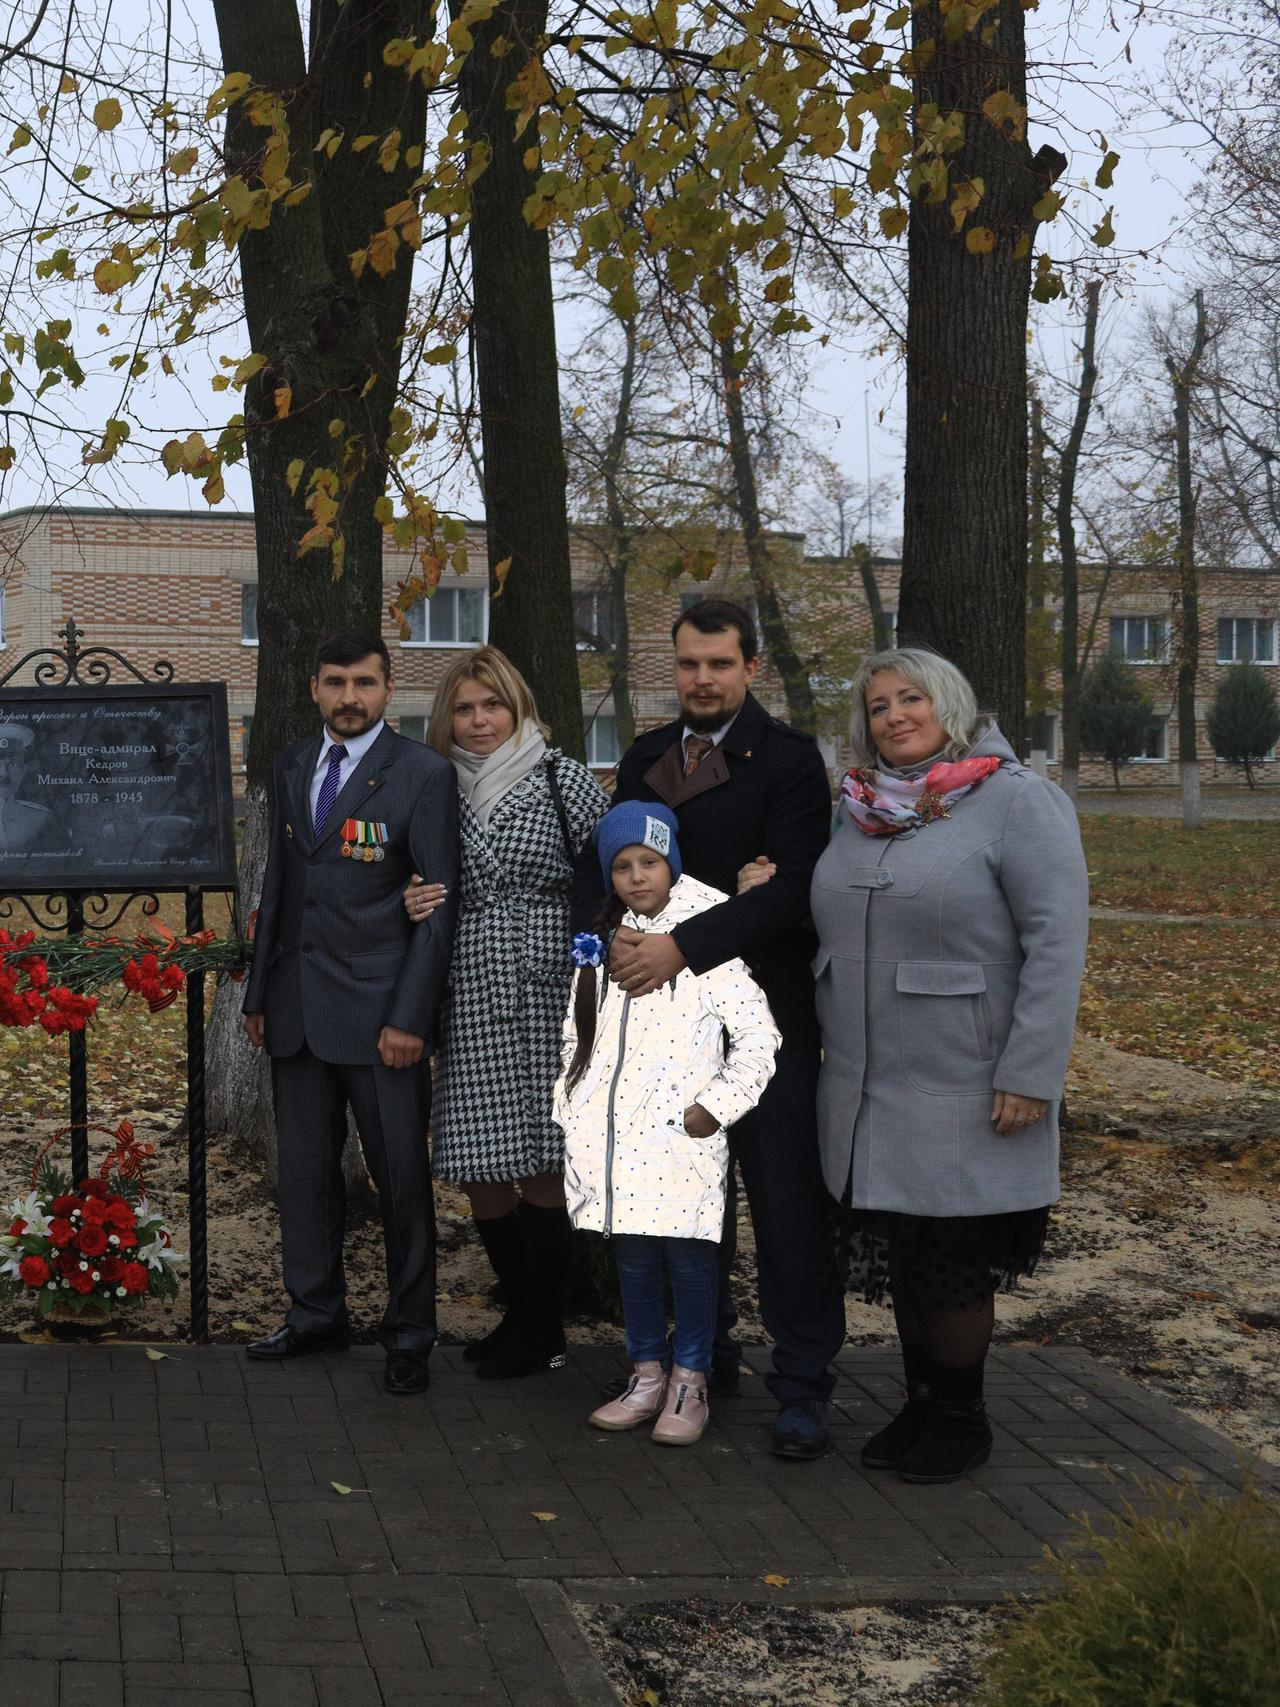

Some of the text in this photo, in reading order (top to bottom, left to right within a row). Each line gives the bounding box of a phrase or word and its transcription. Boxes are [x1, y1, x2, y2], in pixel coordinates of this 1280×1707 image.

[92, 706, 162, 721] Отечеству
[59, 742, 157, 757] Вице-адмирал
[85, 758, 128, 770] Кедров
[37, 773, 177, 786] Михаил Александрович
[70, 793, 98, 804] 1878
[115, 792, 143, 803] 1945
